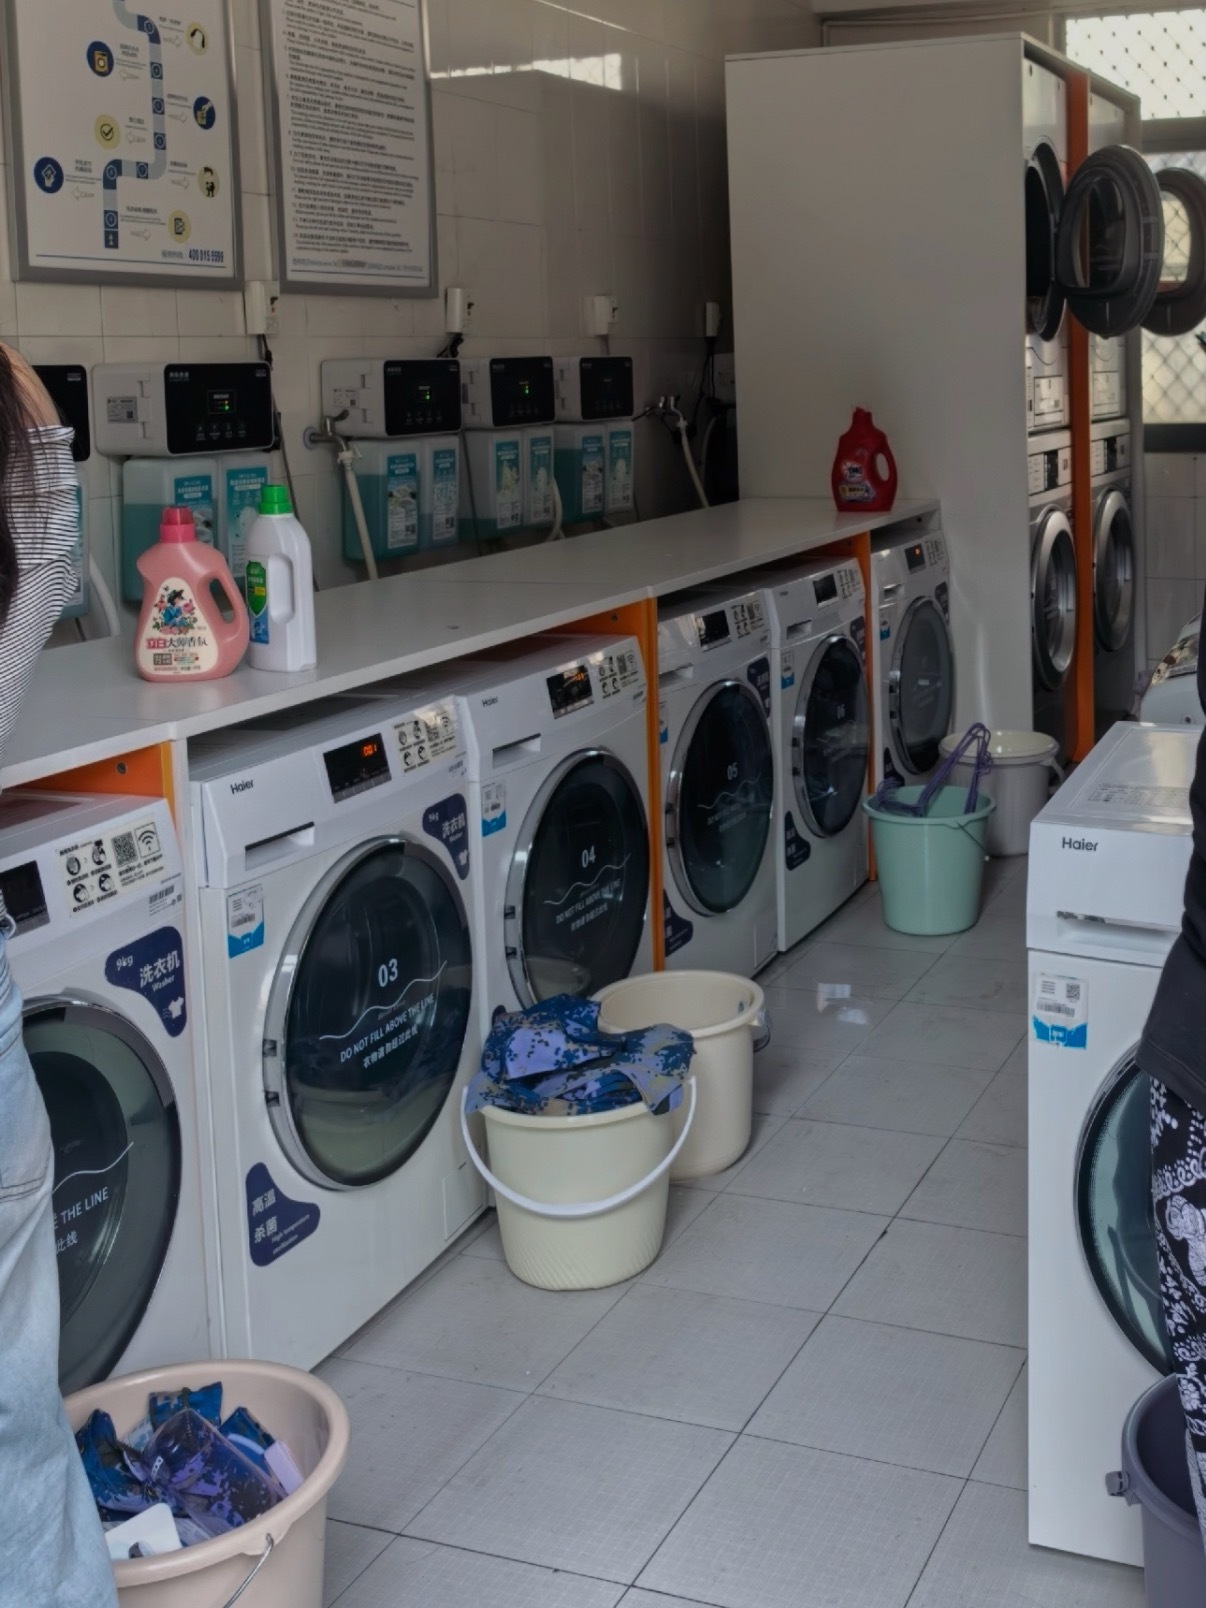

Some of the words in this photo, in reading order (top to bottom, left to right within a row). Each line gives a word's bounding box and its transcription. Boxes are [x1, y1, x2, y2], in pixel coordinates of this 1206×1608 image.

[230, 779, 254, 795] Haier
[581, 845, 596, 868] 04
[1061, 836, 1099, 851] Haier
[116, 955, 133, 971] 9kg
[139, 950, 180, 988] 洗衣机
[378, 958, 398, 988] 03
[340, 1047, 352, 1063] DO
[353, 1037, 369, 1055] NOT
[370, 1028, 385, 1044] FILL
[385, 1011, 407, 1033] ABOVE
[60, 1201, 83, 1224] THE
[84, 1186, 109, 1211] LINE
[251, 1188, 276, 1217] 高温
